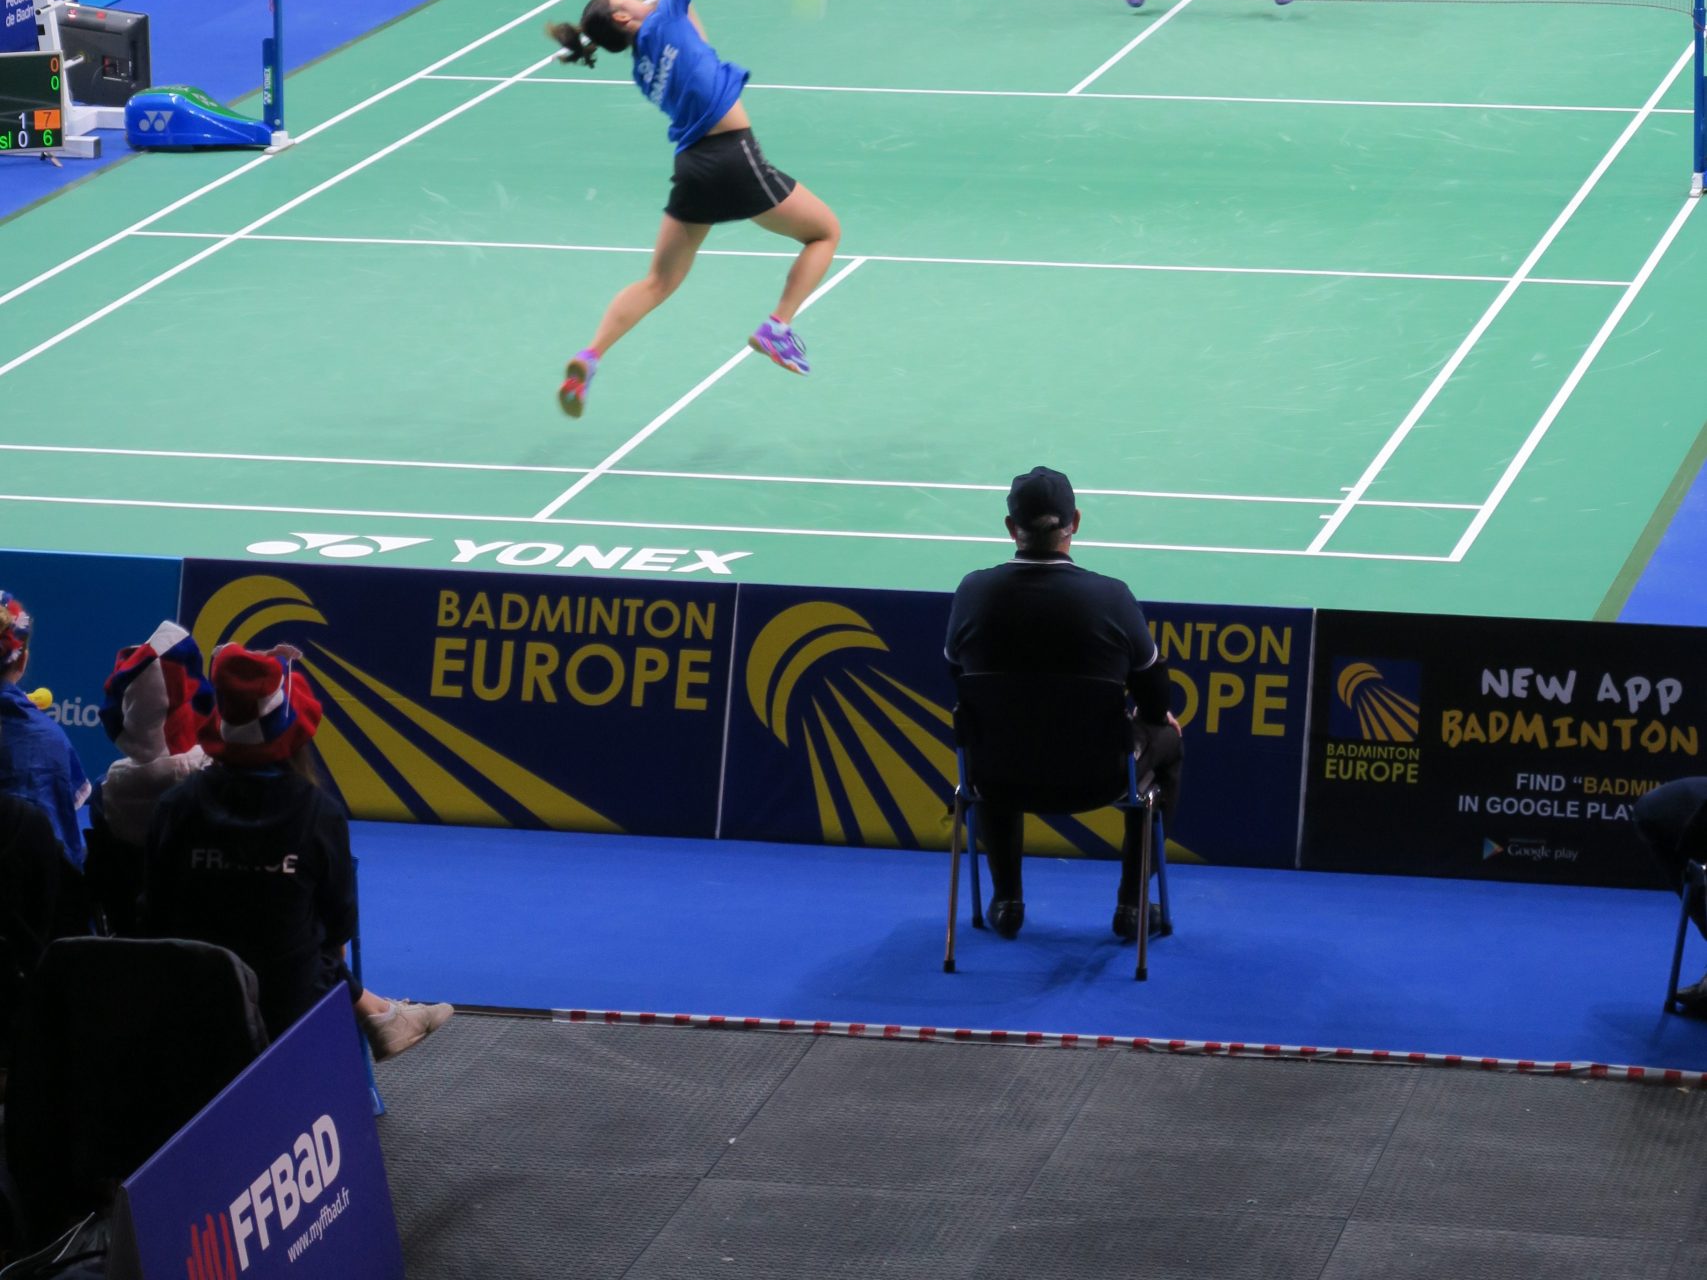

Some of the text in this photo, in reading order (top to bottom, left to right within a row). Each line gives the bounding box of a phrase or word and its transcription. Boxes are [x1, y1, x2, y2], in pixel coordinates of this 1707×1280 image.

[50, 57, 59, 72] 0
[50, 75, 60, 90] 0
[18, 111, 52, 129] 1 7
[18, 130, 28, 148] 0
[43, 129, 53, 146] 6
[451, 539, 754, 574] YONEX
[437, 590, 716, 640] BADMINTON
[430, 636, 712, 711] EUROPE
[1168, 668, 1289, 737] OPE
[1481, 668, 1683, 716] NEW APP
[1441, 710, 1699, 756] BADMINTON
[1326, 743, 1420, 761] BADMINTON
[1325, 759, 1419, 784] EUROPE
[1516, 773, 1566, 792] FIND
[1457, 795, 1480, 813] IN
[1485, 796, 1580, 818] GOOGLE
[1507, 844, 1579, 862] Google play
[287, 1186, 350, 1263] www.myffbad.fr
